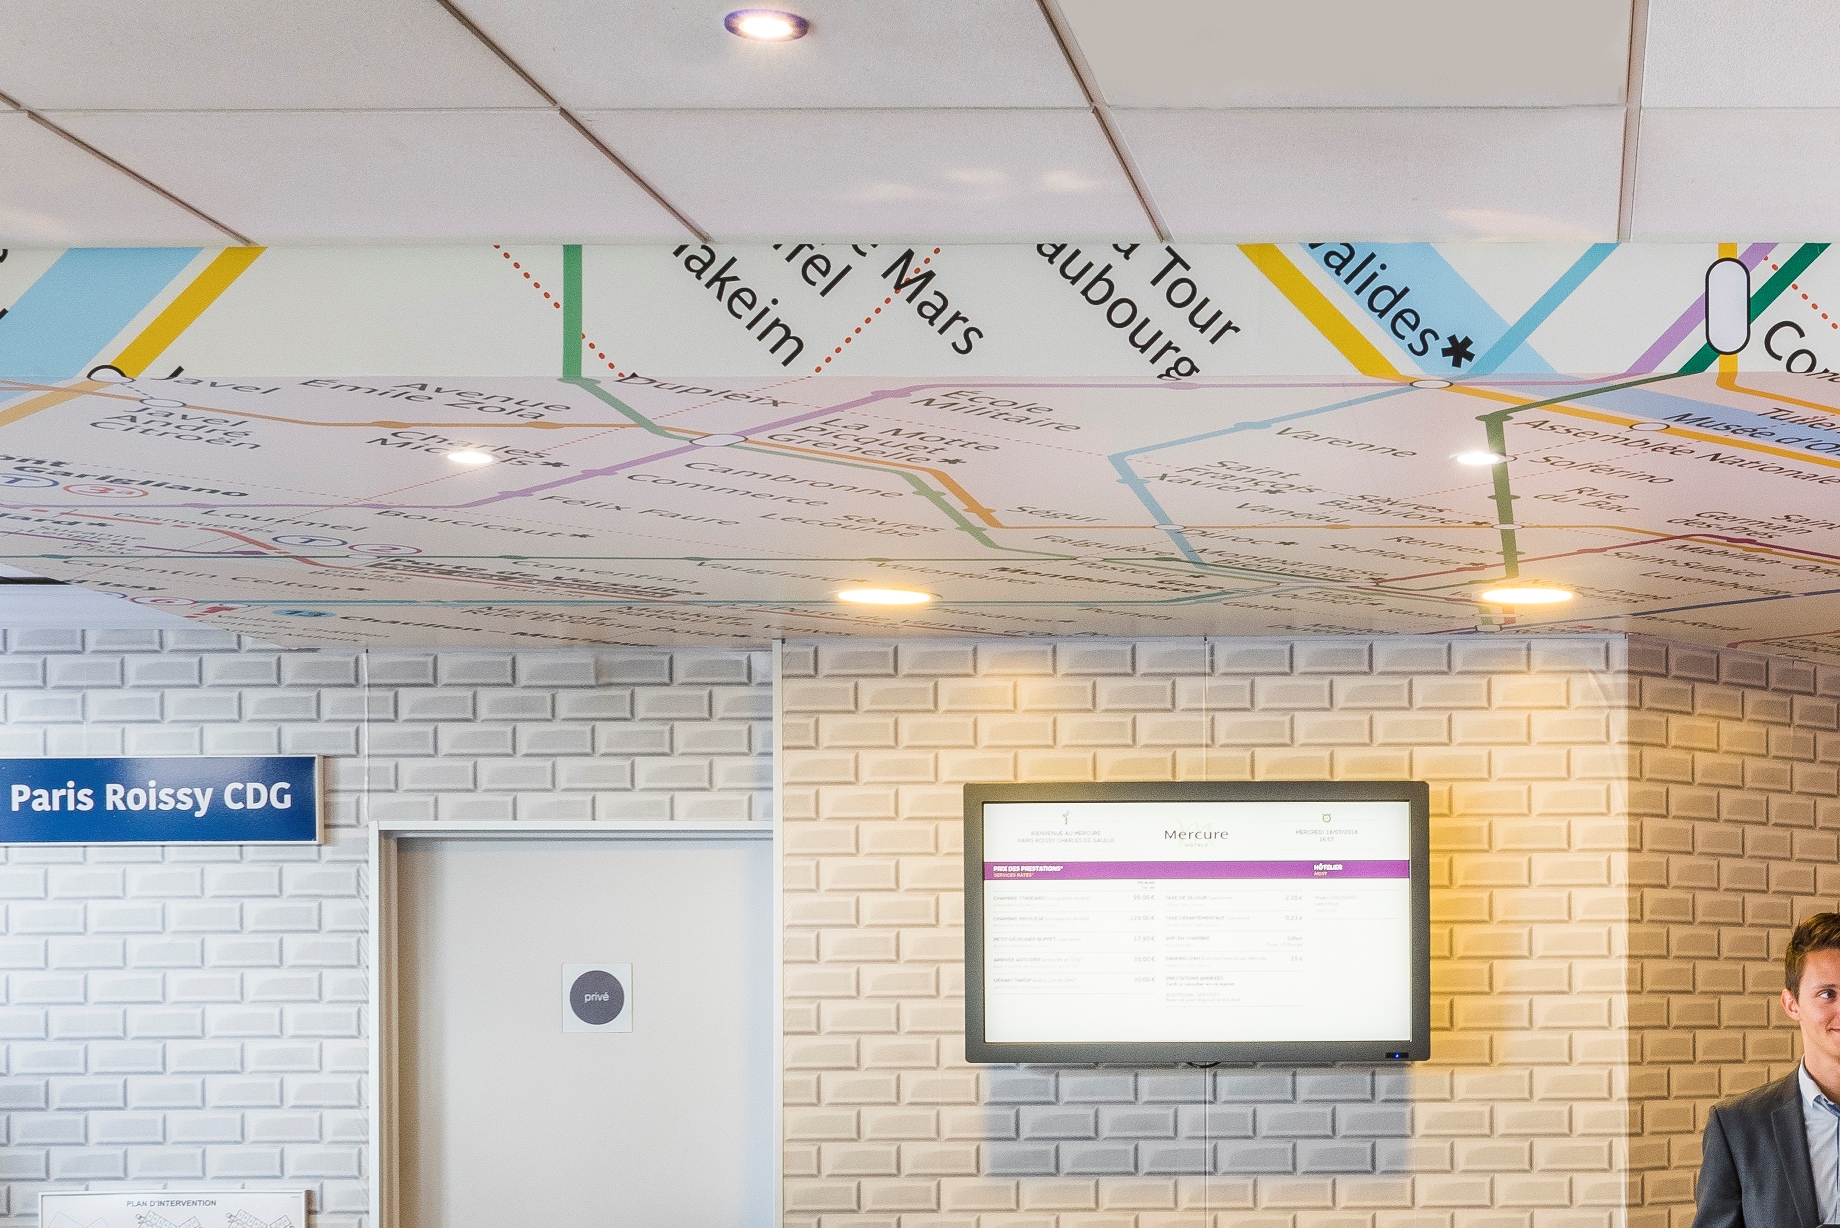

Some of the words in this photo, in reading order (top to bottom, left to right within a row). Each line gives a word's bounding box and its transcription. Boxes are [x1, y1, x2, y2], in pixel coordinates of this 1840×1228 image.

[881, 248, 984, 355] Mars
[1149, 245, 1242, 345] Tour
[393, 383, 571, 413] Avenue
[615, 371, 790, 407] Dupleix
[444, 400, 545, 420] Zola
[909, 397, 1081, 432] Militaire
[1662, 412, 1776, 439] Musée
[767, 432, 931, 463] Grenelle
[818, 418, 871, 432] La
[877, 426, 1000, 452] Motte
[1275, 427, 1417, 459] Varenne
[1514, 419, 1697, 457] Assemblée
[685, 462, 904, 498] Cambronne
[1205, 460, 1301, 480] Saint
[1528, 454, 1675, 484] Solférino
[627, 474, 829, 507] Commerce
[1235, 502, 1350, 524] Vaneau
[11, 780, 94, 812] Paris
[105, 780, 214, 818] Roissy
[223, 782, 292, 810] CDG
[1164, 828, 1230, 841] Mercure
[584, 991, 610, 1004] privé
[126, 1200, 148, 1208] PLAN
[149, 1200, 217, 1208] D'INTERVENTION
